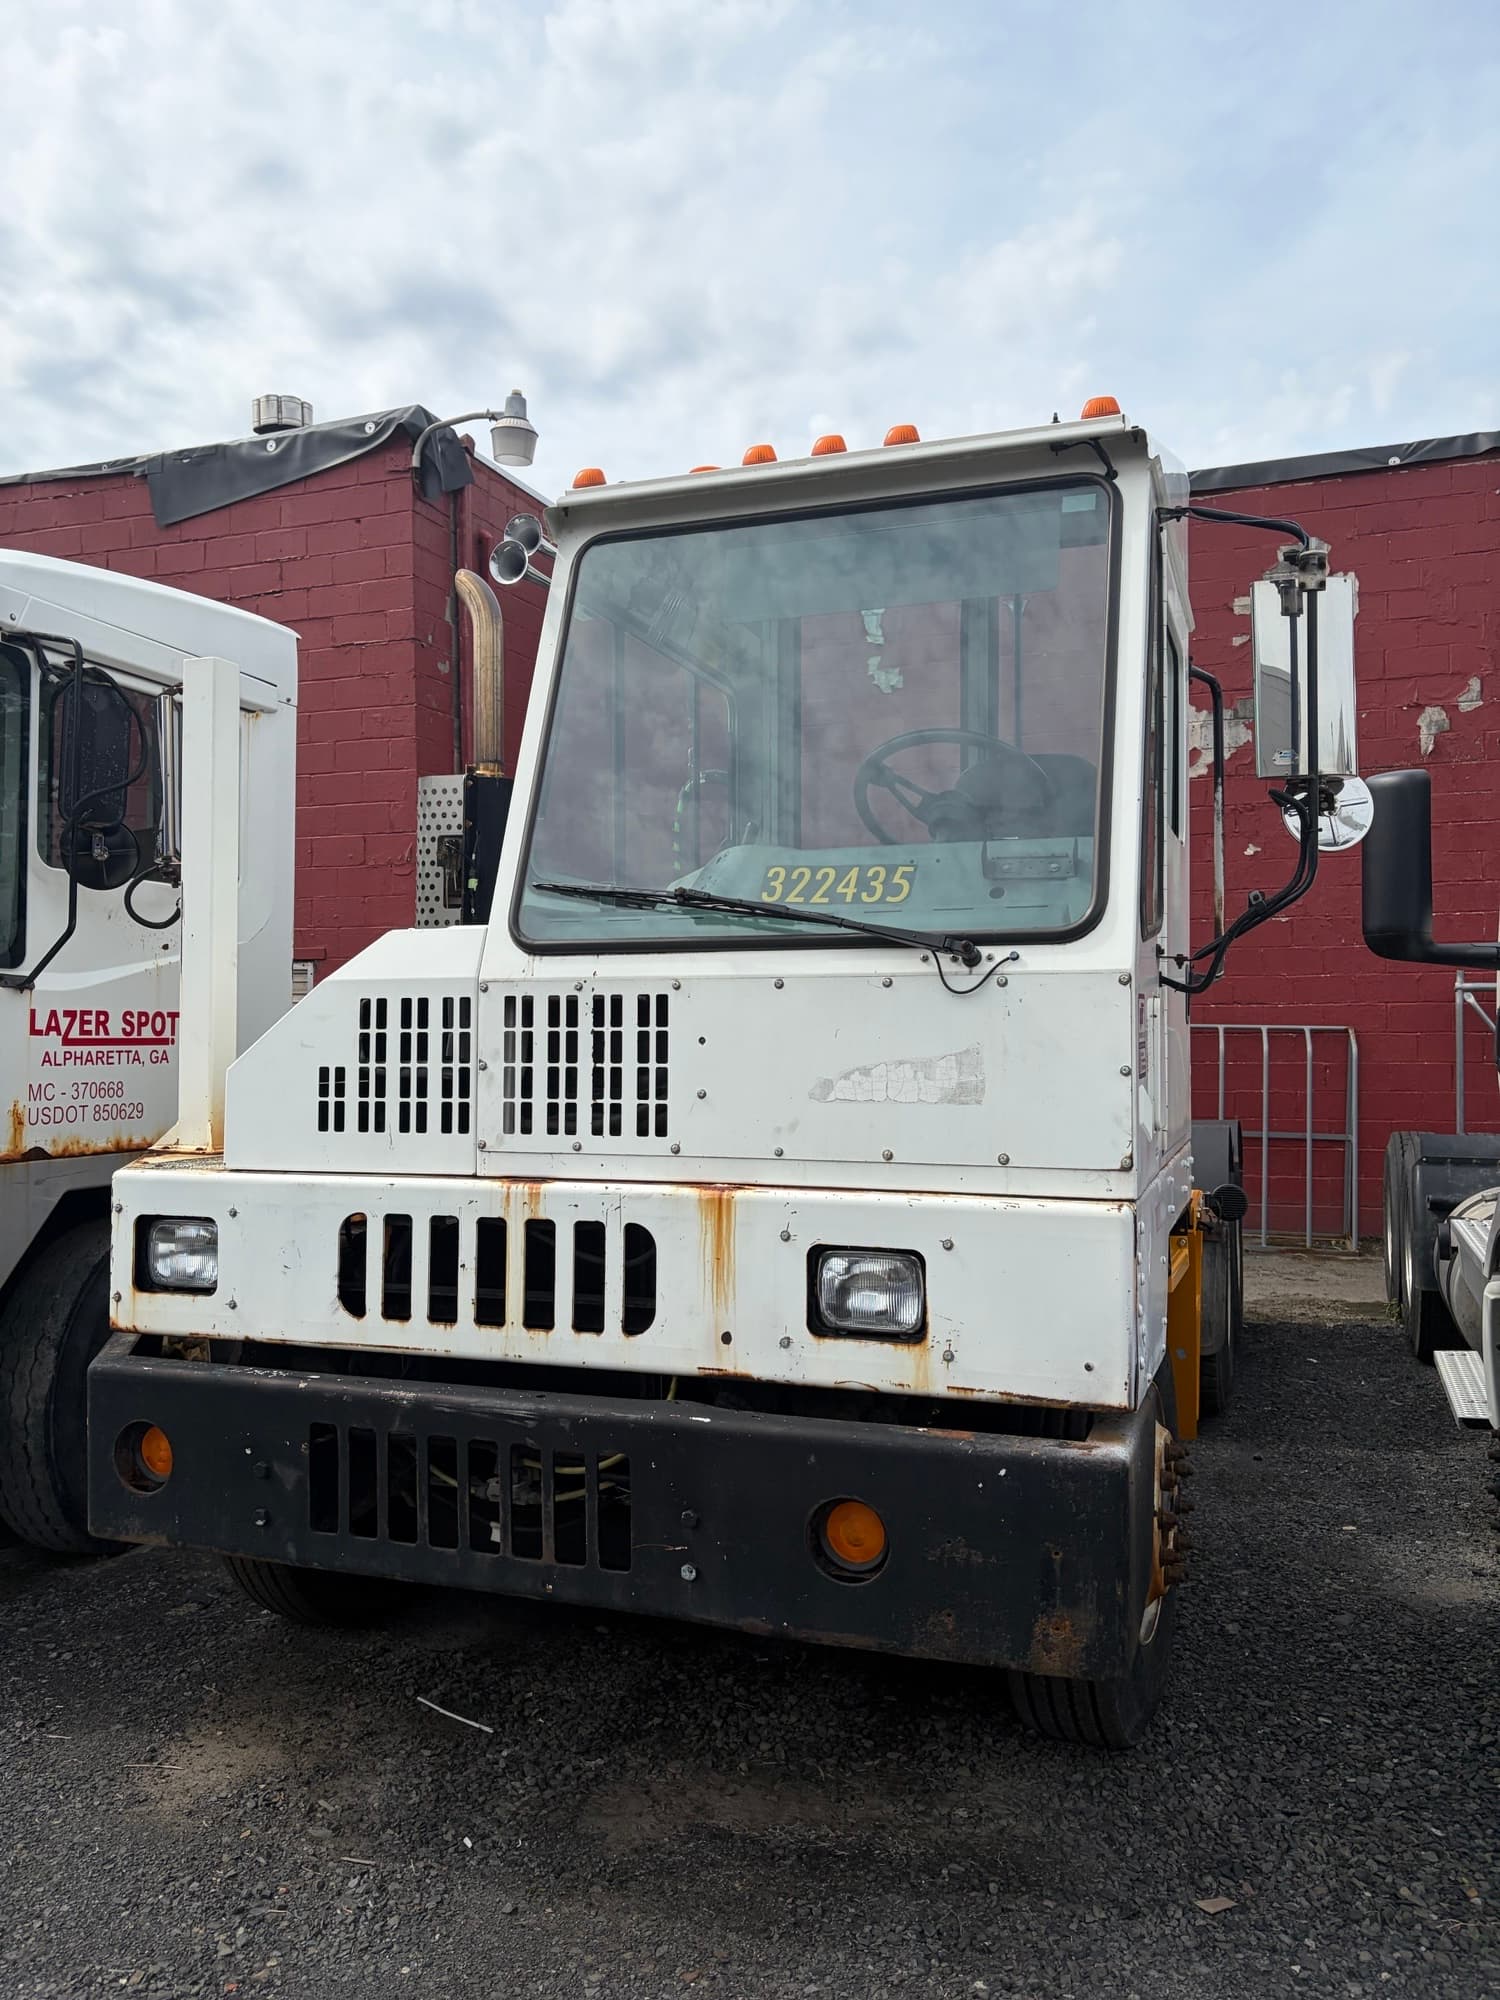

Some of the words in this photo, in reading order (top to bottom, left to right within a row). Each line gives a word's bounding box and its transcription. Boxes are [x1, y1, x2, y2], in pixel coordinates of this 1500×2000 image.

[761, 866, 915, 904] 322435
[29, 1008, 110, 1046] LAZER
[121, 1011, 180, 1037] SPOT
[41, 1050, 145, 1067] ALPHARETTA,
[149, 1049, 169, 1065] GA
[28, 1082, 55, 1102] MC
[71, 1081, 124, 1101] 370668
[28, 1105, 89, 1126] USDOT
[92, 1102, 144, 1122] 850629
